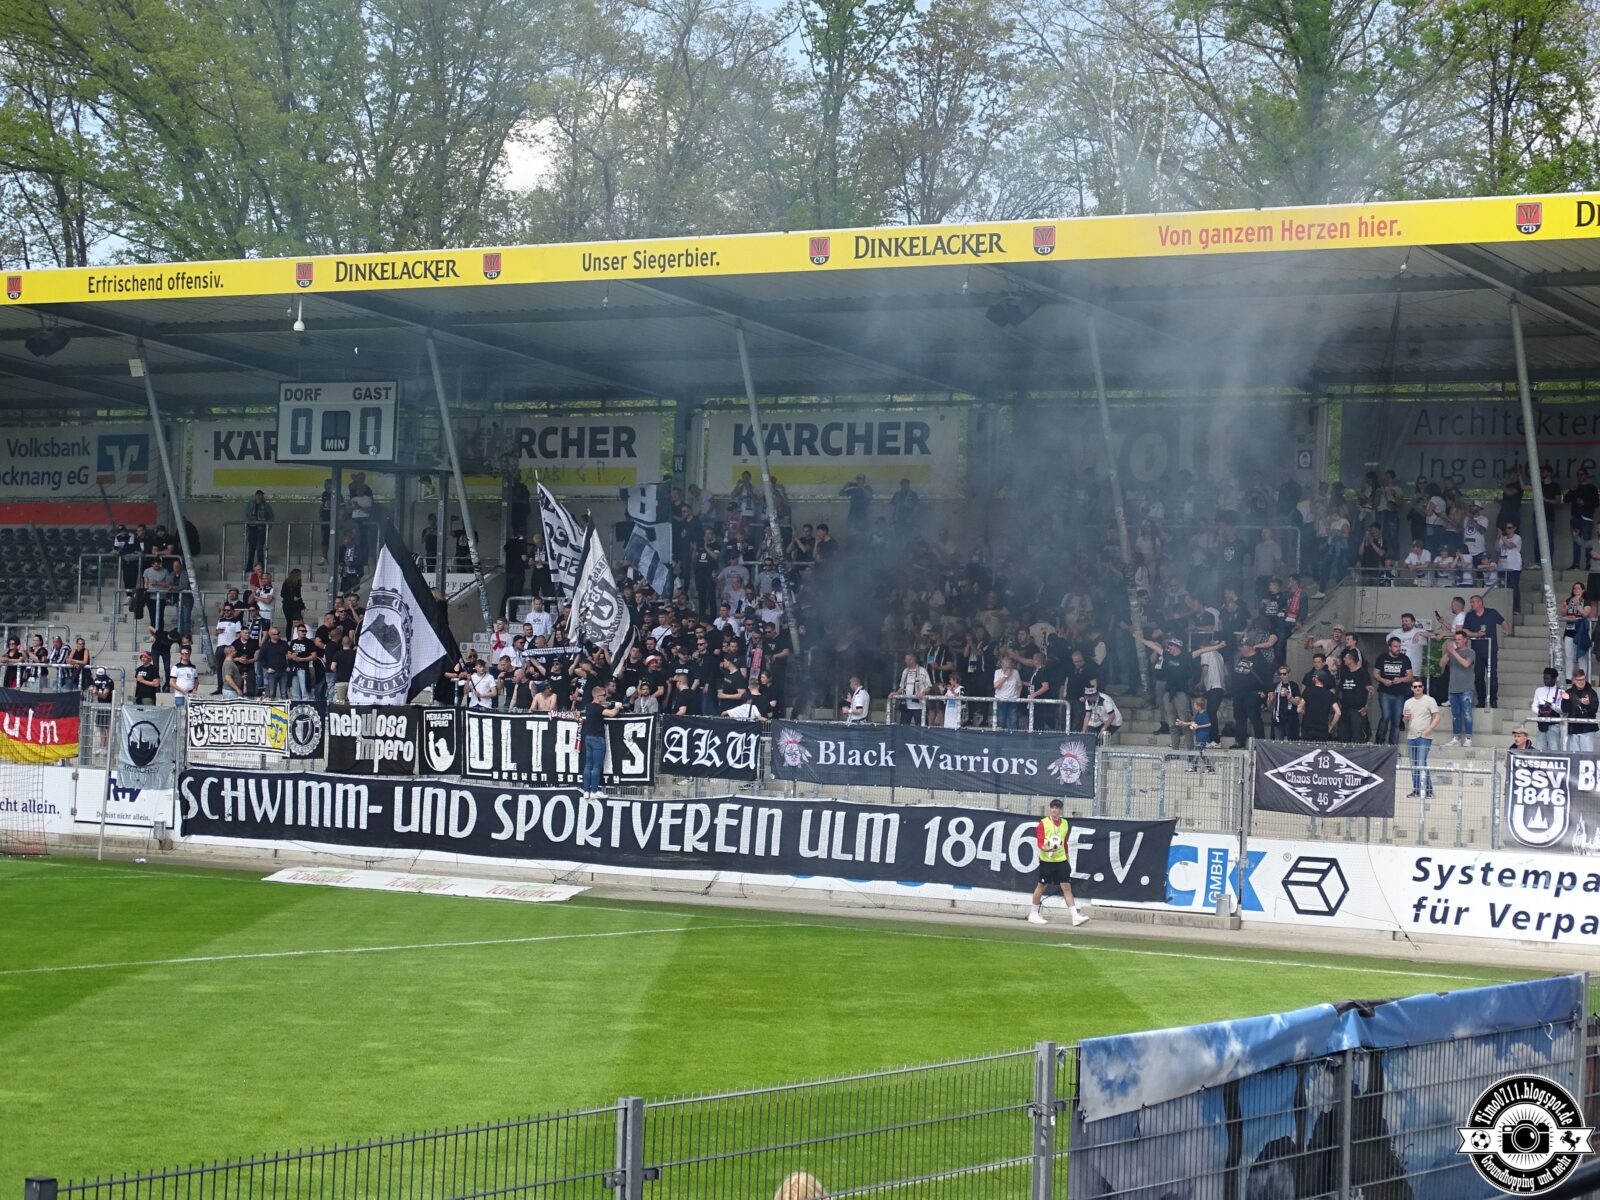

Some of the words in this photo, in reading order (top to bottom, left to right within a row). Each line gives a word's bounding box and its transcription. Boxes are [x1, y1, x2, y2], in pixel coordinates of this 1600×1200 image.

[1158, 224, 1192, 247] Von
[1199, 224, 1273, 250] ganzem
[1281, 219, 1350, 242] Herzen
[1357, 215, 1402, 239] hier.
[1520, 225, 1537, 233] CD
[854, 232, 1007, 260] DINKELACKER
[1037, 246, 1051, 254] CD
[335, 259, 460, 283] DINKELACKER
[582, 252, 628, 272] Unser
[633, 247, 720, 274] Siegerbier.
[813, 256, 826, 264] CD
[88, 273, 163, 294] Erfrischend
[167, 270, 224, 290] offensiv.
[486, 271, 499, 279] CD
[284, 387, 323, 401] DORF
[352, 386, 392, 400] GAST
[290, 407, 313, 455] 0
[358, 406, 383, 455] 0
[733, 421, 932, 457] KÄRCHER
[6, 435, 91, 458] Volksbank
[325, 438, 346, 450] MIN
[0, 465, 62, 491] cknang
[67, 466, 89, 485] eG
[3, 708, 59, 744] ulm
[205, 706, 272, 726] SEKTION
[329, 708, 408, 739] nebulosa
[426, 713, 453, 721] NEBULOSA
[209, 725, 266, 745] SENDEN
[468, 717, 647, 775] ULTRS
[355, 737, 414, 773] impero
[816, 740, 896, 768] Black
[904, 742, 1039, 776] Warriors
[1317, 756, 1330, 769] 18
[1515, 759, 1566, 770] FUSSBALL
[492, 771, 548, 782] BROKEN
[557, 775, 620, 785] SOCTY
[1285, 772, 1311, 785] Chaos
[1312, 773, 1343, 788] Convoy
[1344, 774, 1362, 786] Ulm
[1514, 768, 1566, 789] SSV
[22, 799, 60, 815] allein.
[1317, 792, 1329, 805] 46
[1513, 786, 1566, 806] 1846
[117, 811, 132, 819] nicht
[393, 785, 478, 839] UND
[491, 793, 783, 857] SPORTVEREIN
[798, 808, 900, 865] ULM
[924, 815, 1040, 875] 1846
[1067, 825, 1150, 885] E.V.
[1208, 851, 1224, 904] GMBH
[1412, 856, 1600, 898] Systempa
[1412, 896, 1470, 926] für
[1489, 902, 1600, 940] Verpa
